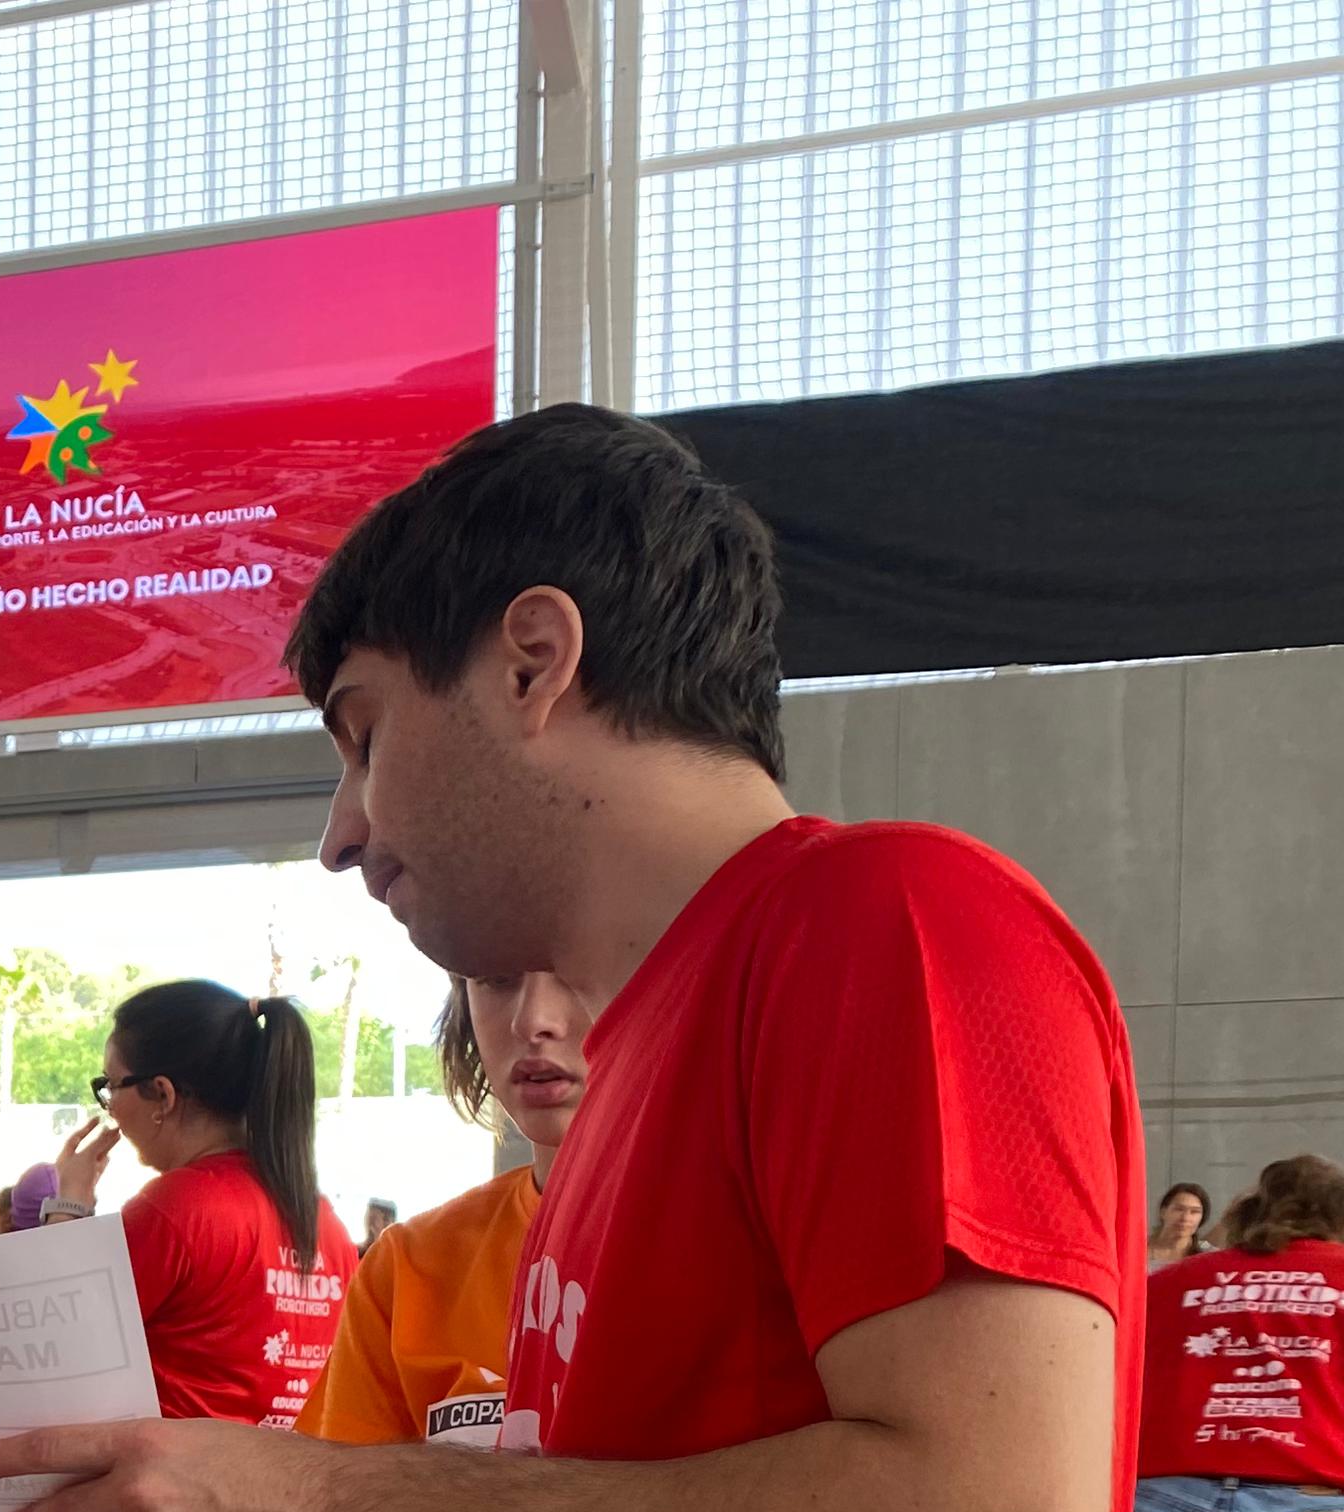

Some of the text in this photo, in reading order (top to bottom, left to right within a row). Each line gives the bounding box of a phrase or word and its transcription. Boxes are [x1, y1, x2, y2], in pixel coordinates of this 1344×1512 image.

[3, 486, 146, 530] LA NUCÍA
[48, 526, 69, 543] LA
[71, 514, 164, 540] EDUCACIÓN
[166, 514, 179, 529] Y
[180, 512, 202, 528] LA
[204, 504, 277, 525] CULTURA
[30, 578, 130, 612] HECHO
[134, 563, 273, 600] REALIDAD
[278, 1246, 325, 1271] V CA
[1216, 1270, 1327, 1285] V COPA
[435, 1401, 505, 1432] V COPA
